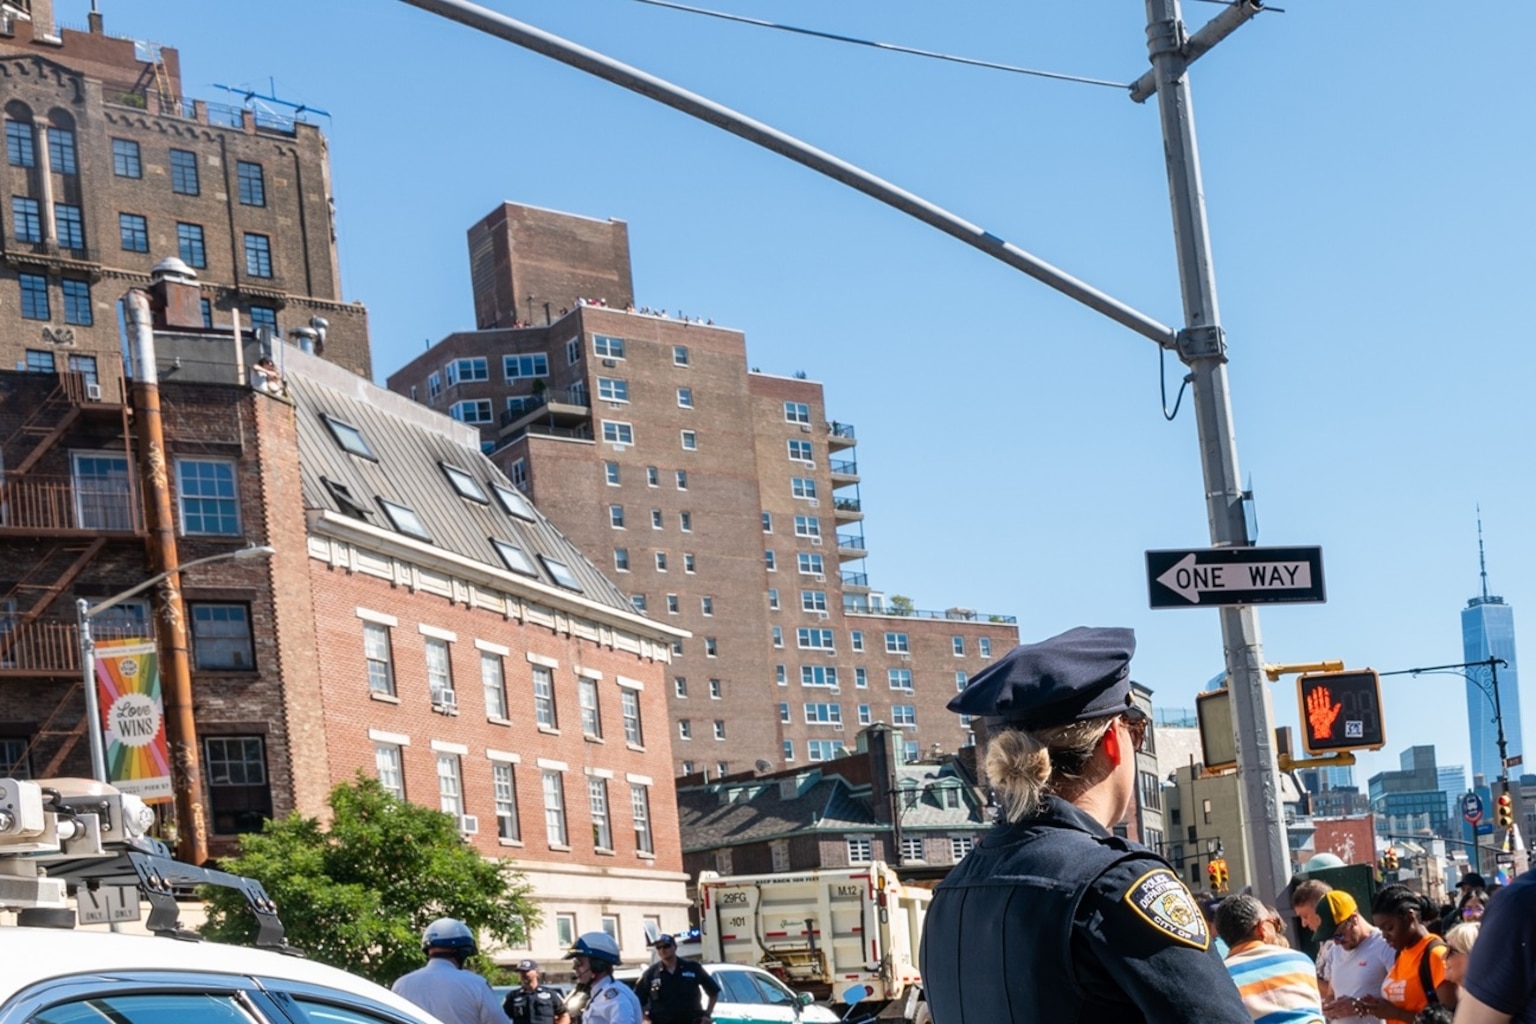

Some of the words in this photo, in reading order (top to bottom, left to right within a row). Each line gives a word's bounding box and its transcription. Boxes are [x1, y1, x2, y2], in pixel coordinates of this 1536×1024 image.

[1176, 567, 1225, 589] ONE
[1249, 565, 1300, 587] WAY
[116, 701, 152, 719] Love
[118, 717, 153, 738] WINS
[1153, 915, 1177, 932] CITY
